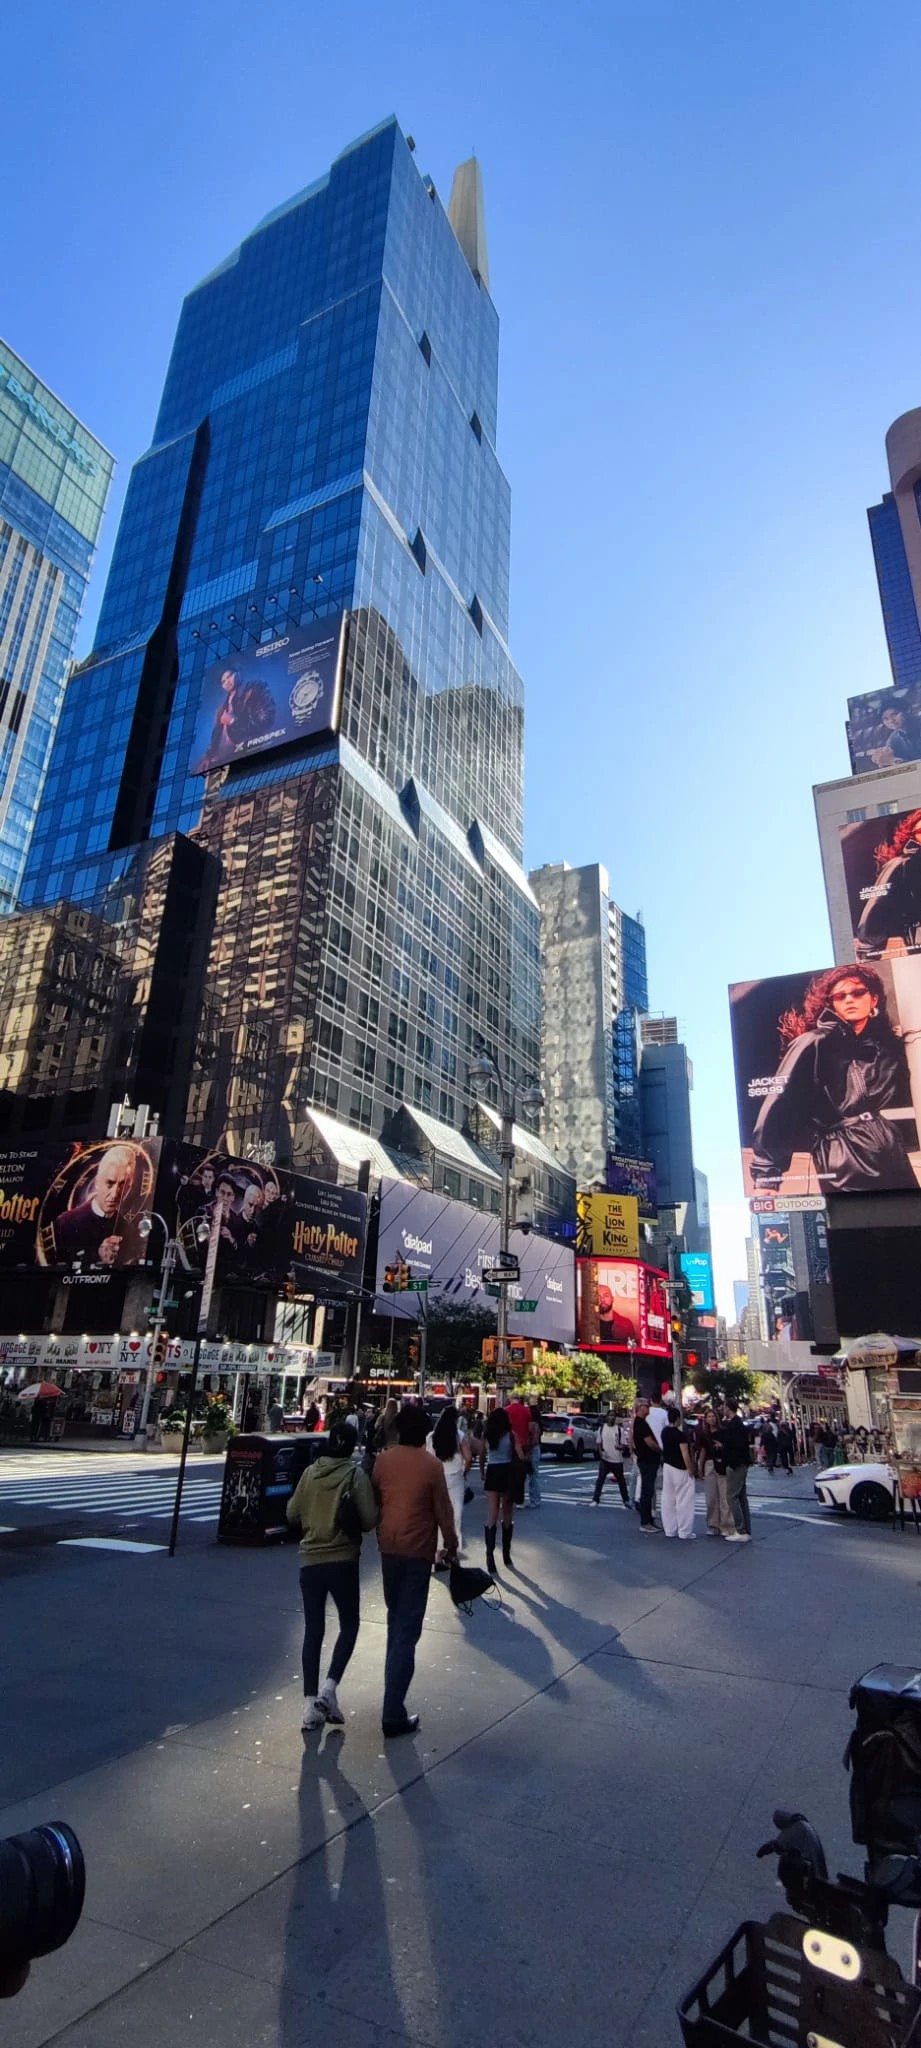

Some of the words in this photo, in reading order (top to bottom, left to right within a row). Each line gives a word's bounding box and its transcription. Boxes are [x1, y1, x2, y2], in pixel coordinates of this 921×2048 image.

[256, 637, 290, 657] SEIKO
[247, 728, 286, 748] PROSPEX
[859, 882, 892, 894] JACKET
[747, 1076, 790, 1088] JACKET
[747, 1085, 784, 1098] $69.99
[0, 1164, 26, 1174] ELTON
[608, 1204, 623, 1213] THE
[753, 1201, 773, 1211] BIG
[776, 1200, 822, 1209] OUTDOOR
[291, 1220, 327, 1254] Harry
[326, 1223, 359, 1257] Potter
[404, 1232, 433, 1255] dialpad
[546, 1276, 563, 1293] dialpad
[0, 1342, 28, 1354] UGGAGE
[98, 1342, 114, 1354] NY
[122, 1341, 128, 1351] I
[119, 1351, 141, 1362] NY
